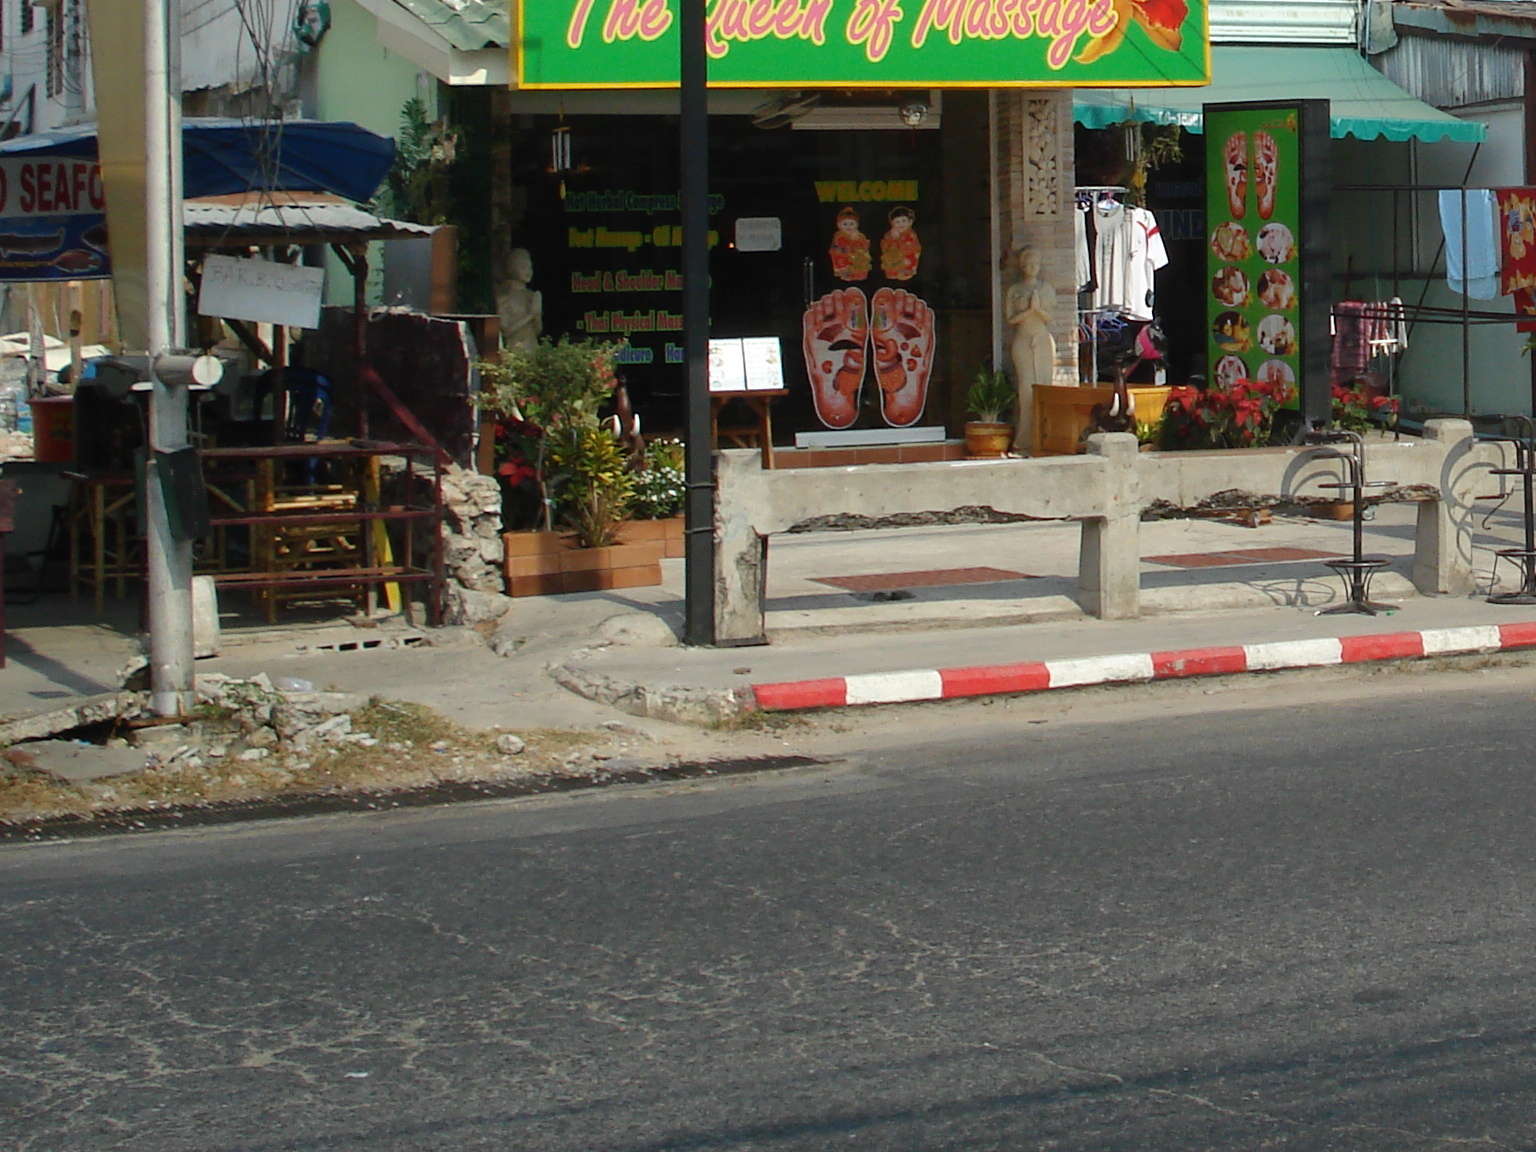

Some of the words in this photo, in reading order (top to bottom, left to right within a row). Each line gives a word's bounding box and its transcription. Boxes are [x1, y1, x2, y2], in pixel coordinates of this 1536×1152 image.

[20, 163, 104, 213] SEAFO
[814, 180, 919, 203] WELCOME
[584, 310, 609, 333] Thai
[611, 309, 655, 337] Physical
[657, 310, 685, 331] Mass
